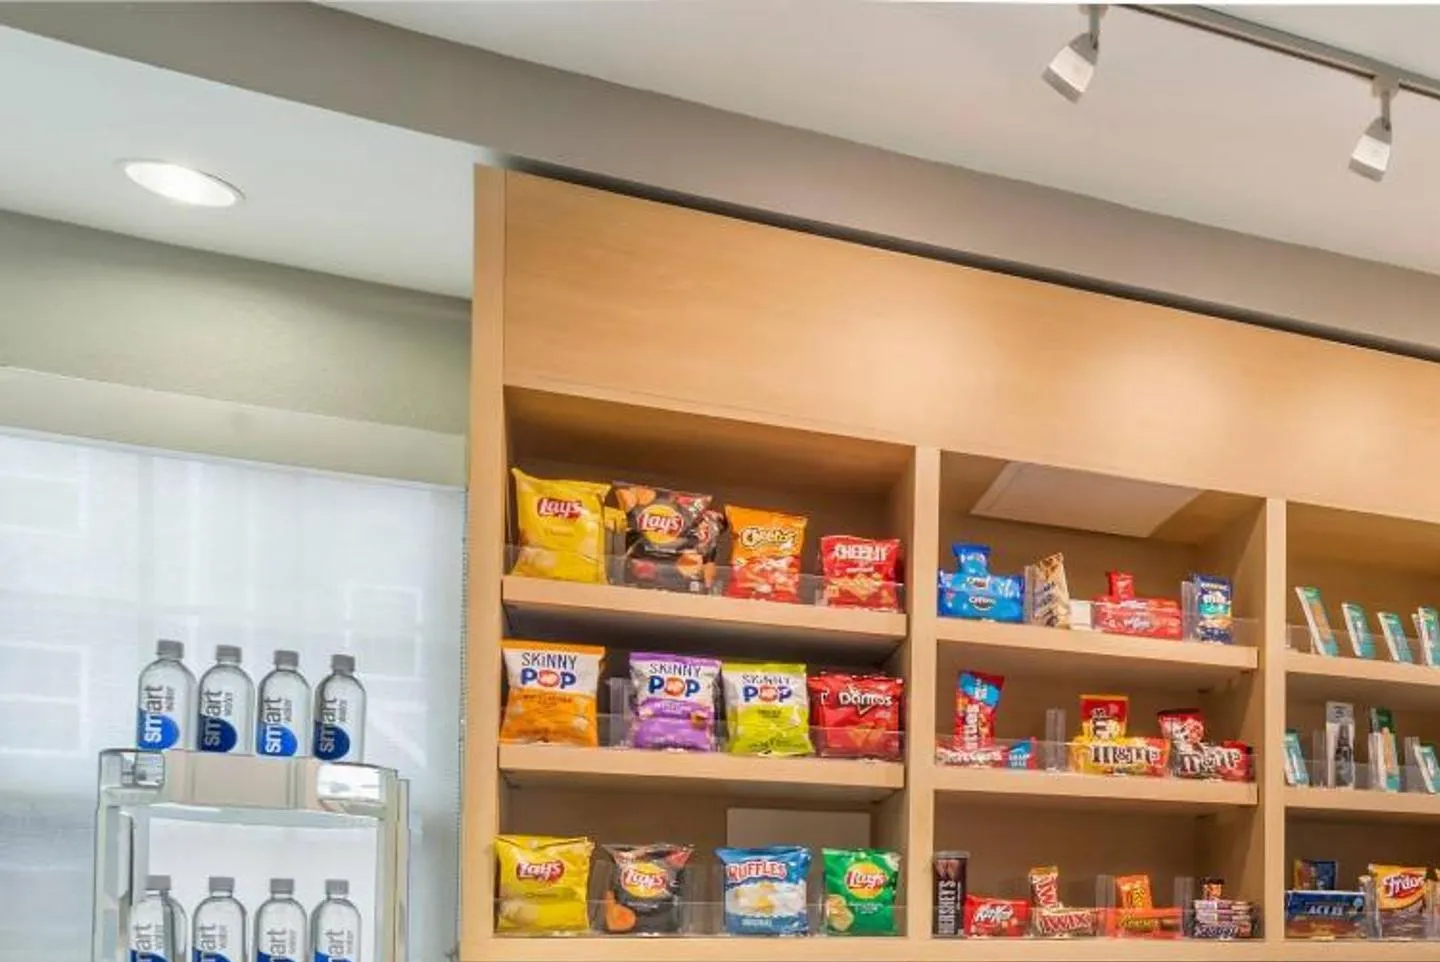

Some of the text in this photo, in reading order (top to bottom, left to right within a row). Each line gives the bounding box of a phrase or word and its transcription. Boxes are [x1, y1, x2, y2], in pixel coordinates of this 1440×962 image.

[520, 667, 577, 690] POP
[648, 674, 701, 698] POP
[743, 684, 793, 704] POP
[727, 860, 788, 884] RUFFLES
